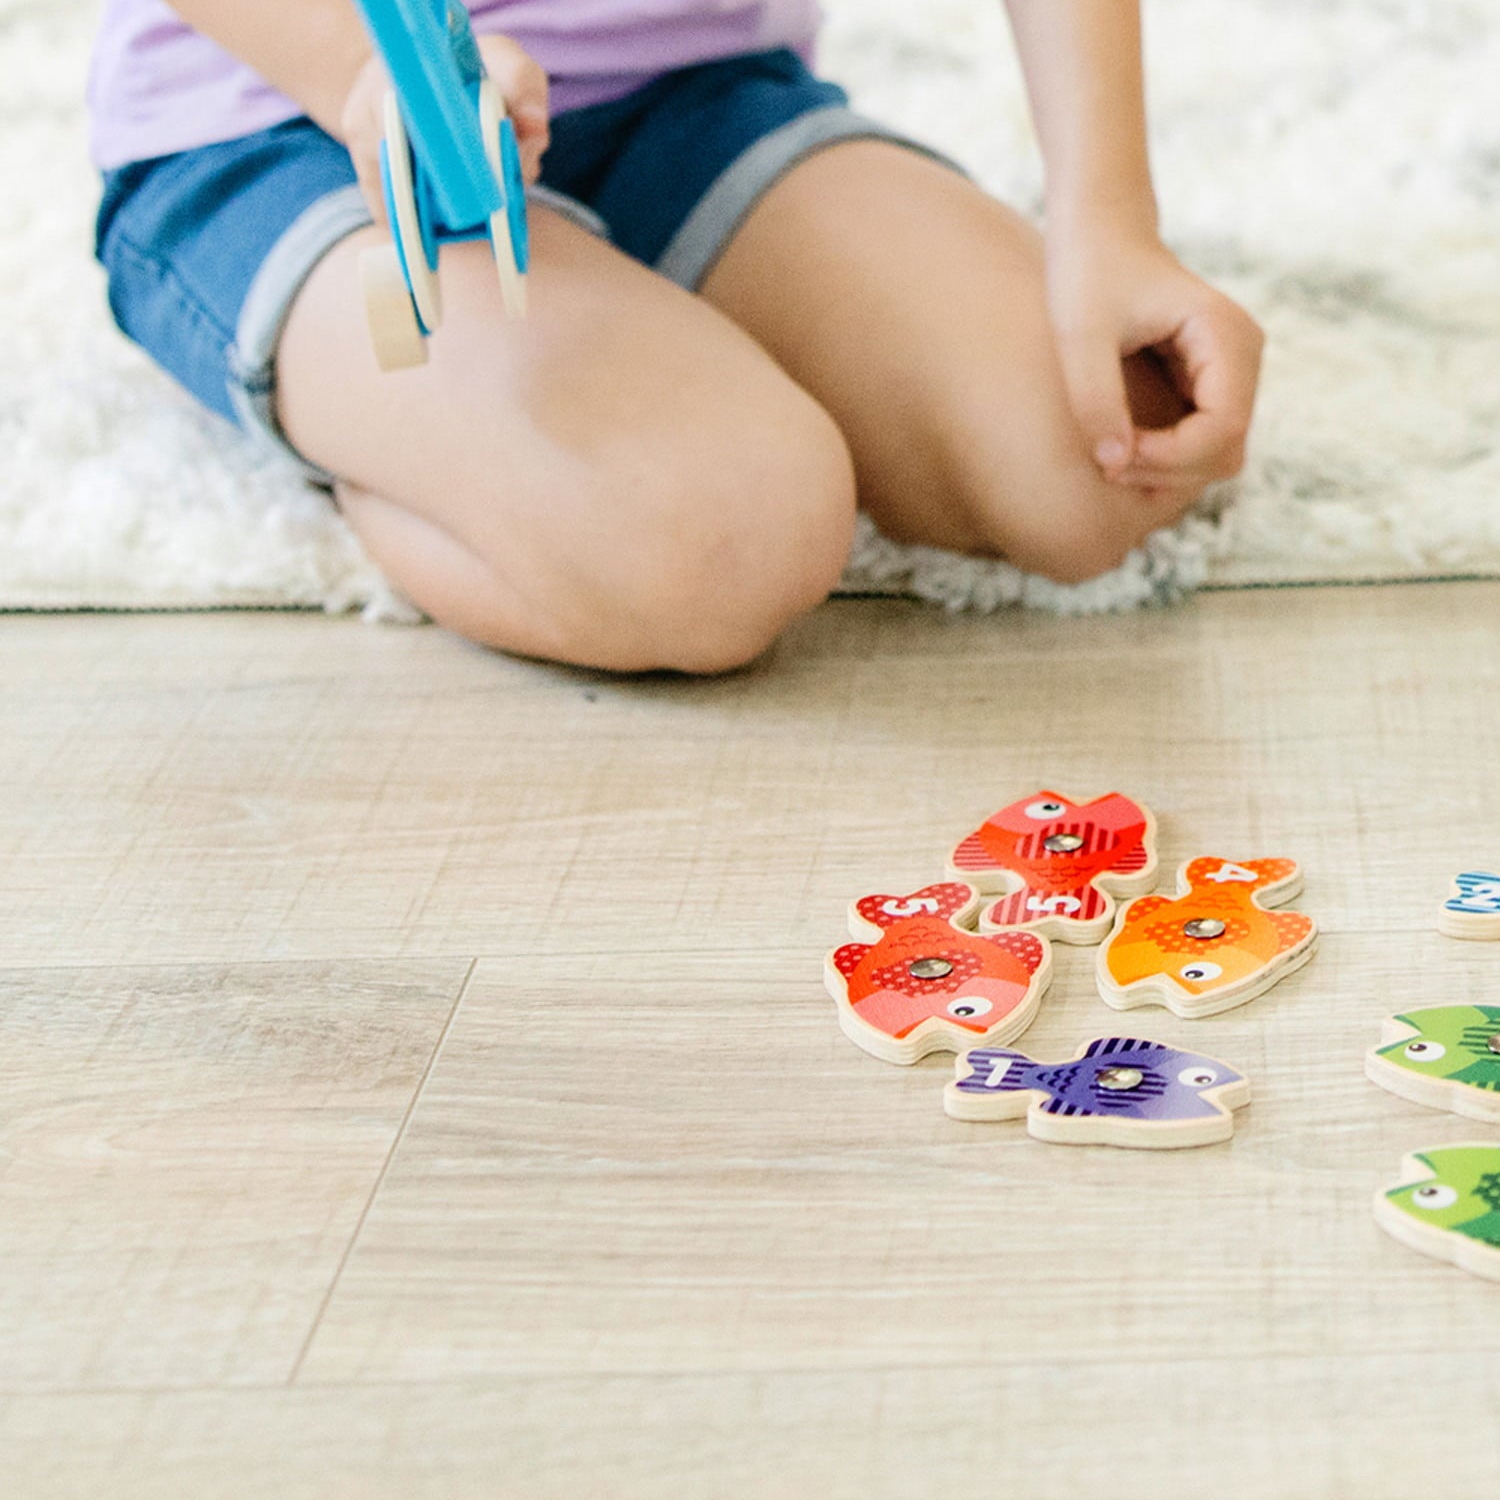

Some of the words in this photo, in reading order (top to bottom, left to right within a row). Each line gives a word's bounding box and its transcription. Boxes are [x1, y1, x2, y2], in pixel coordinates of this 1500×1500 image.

[1206, 863, 1258, 882] 4
[882, 898, 937, 916] 5
[1026, 896, 1081, 912] 5
[984, 1058, 1012, 1086] 1
